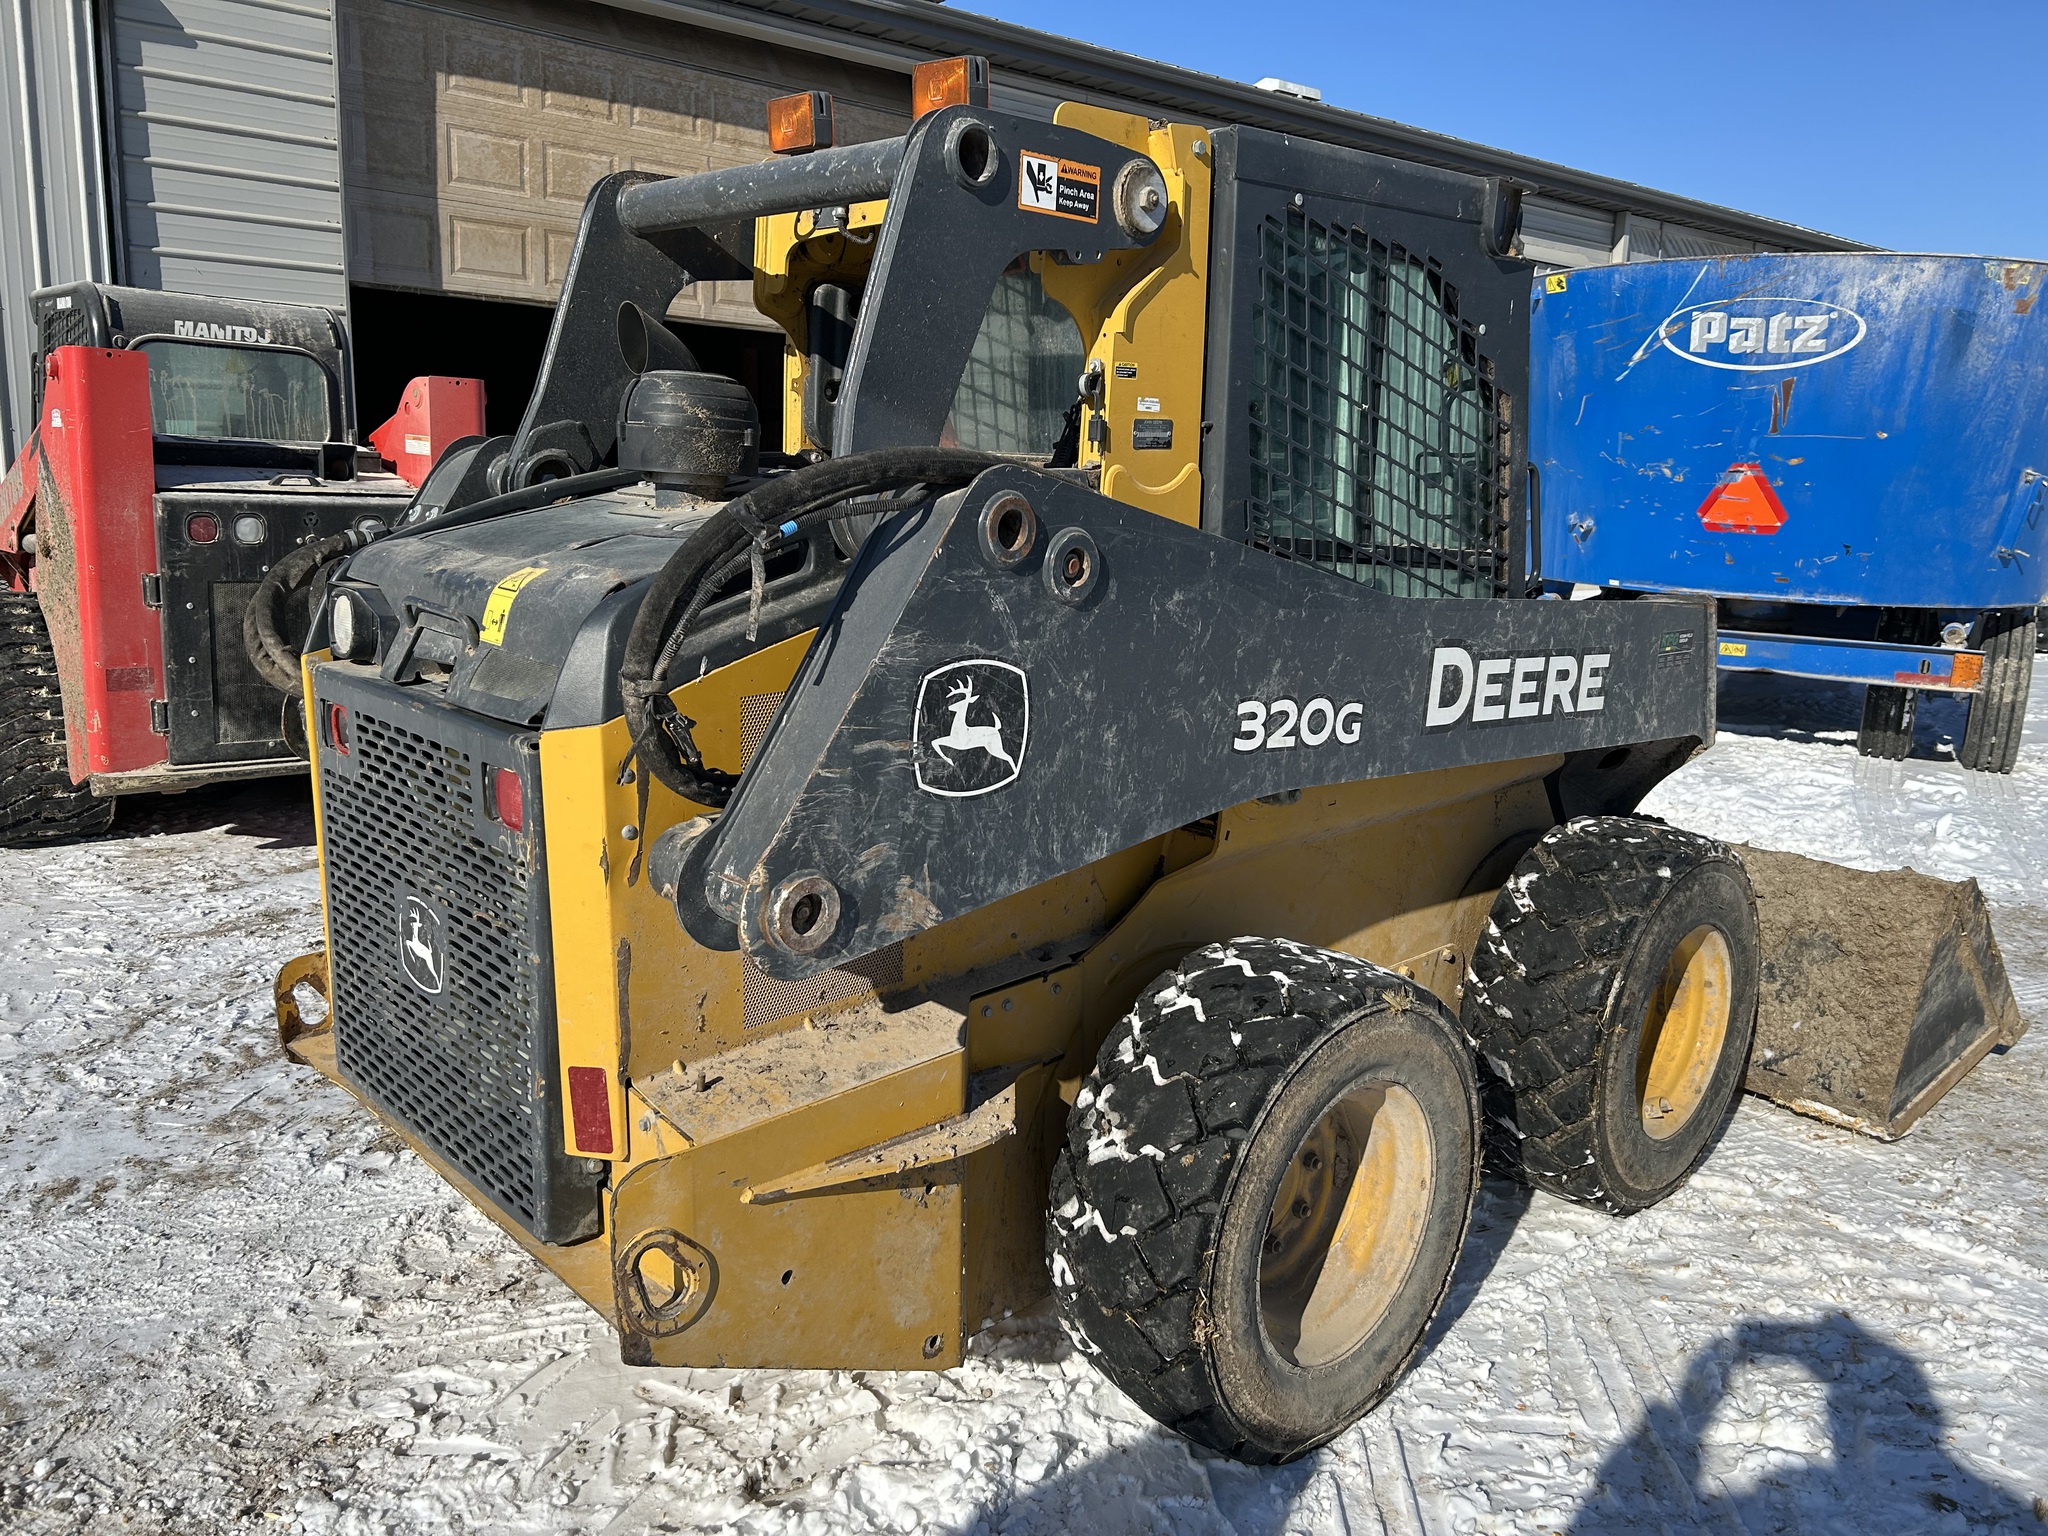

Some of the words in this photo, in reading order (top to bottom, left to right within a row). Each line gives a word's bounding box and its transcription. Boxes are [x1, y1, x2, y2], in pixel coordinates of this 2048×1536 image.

[1067, 166, 1097, 180] WARNING
[1058, 197, 1074, 209] Keep
[1074, 200, 1090, 212] Away
[1059, 184, 1078, 197] Pinch
[1079, 189, 1095, 201] Area
[1689, 311, 1829, 355] Patz
[1425, 647, 1611, 727] DEERE
[1233, 697, 1364, 751] 320G
